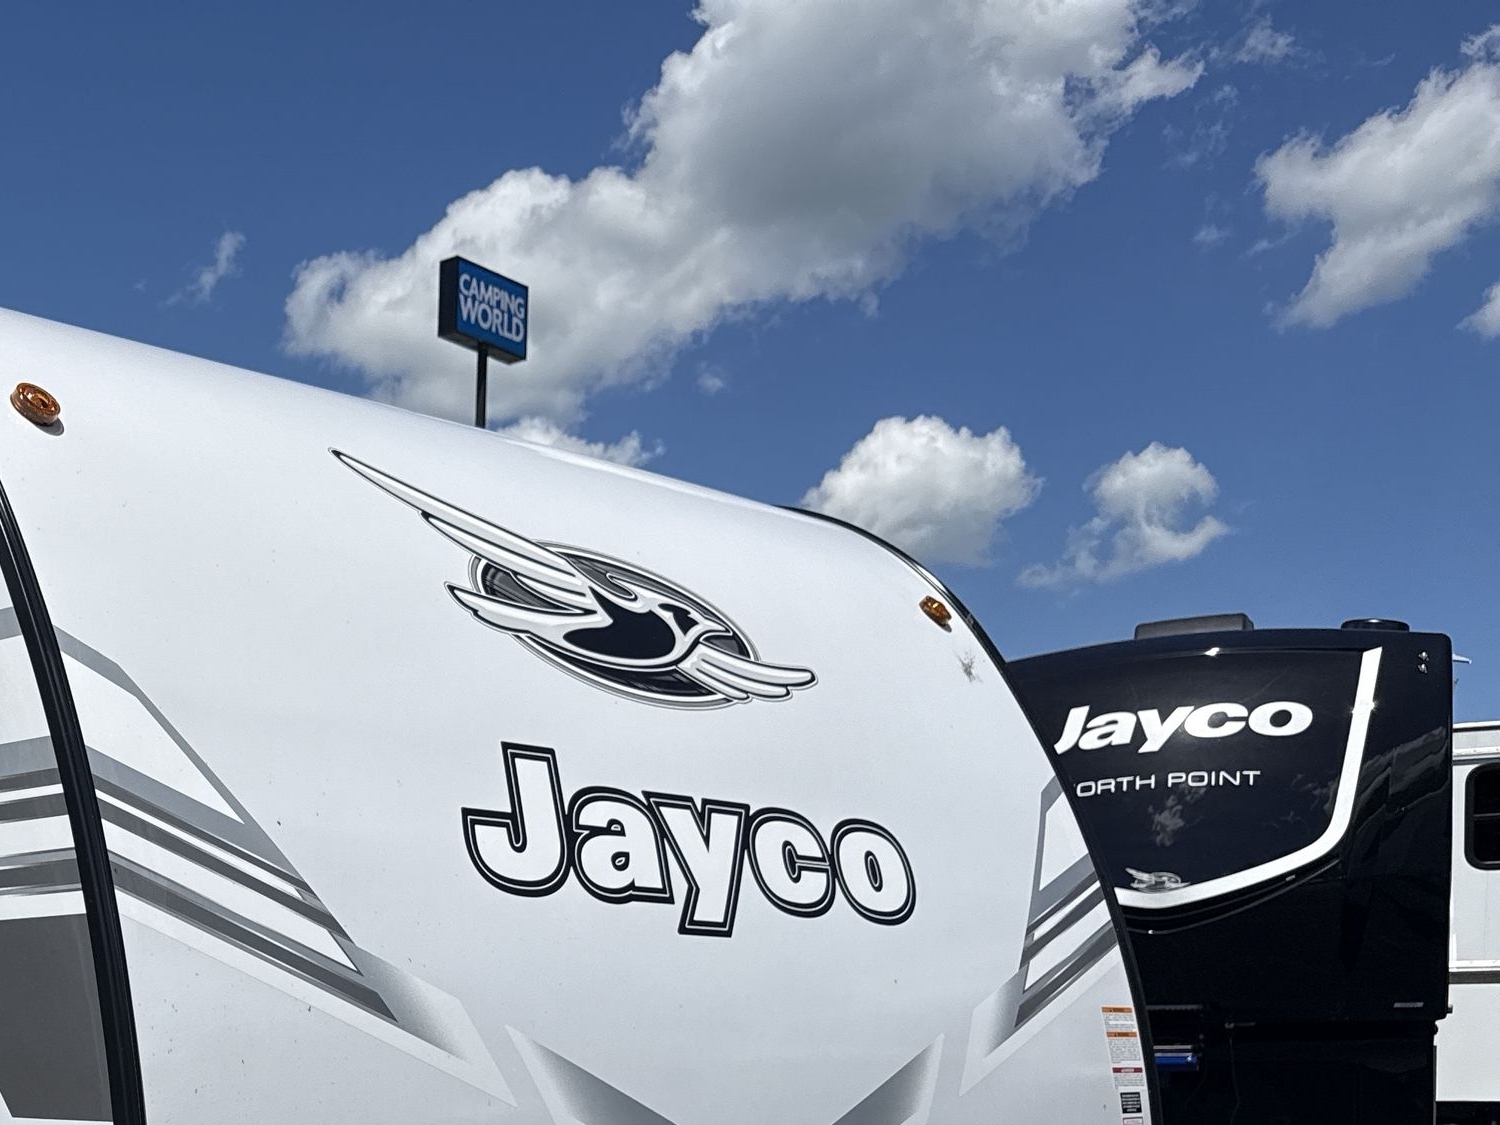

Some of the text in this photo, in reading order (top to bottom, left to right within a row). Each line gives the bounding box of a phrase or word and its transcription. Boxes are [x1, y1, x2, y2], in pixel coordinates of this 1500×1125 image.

[459, 273, 525, 319] CAMPING
[459, 294, 525, 343] WORLD
[1054, 701, 1313, 755] Jayco
[1074, 770, 1261, 797] ORTH POINT
[461, 740, 916, 938] Jayco
